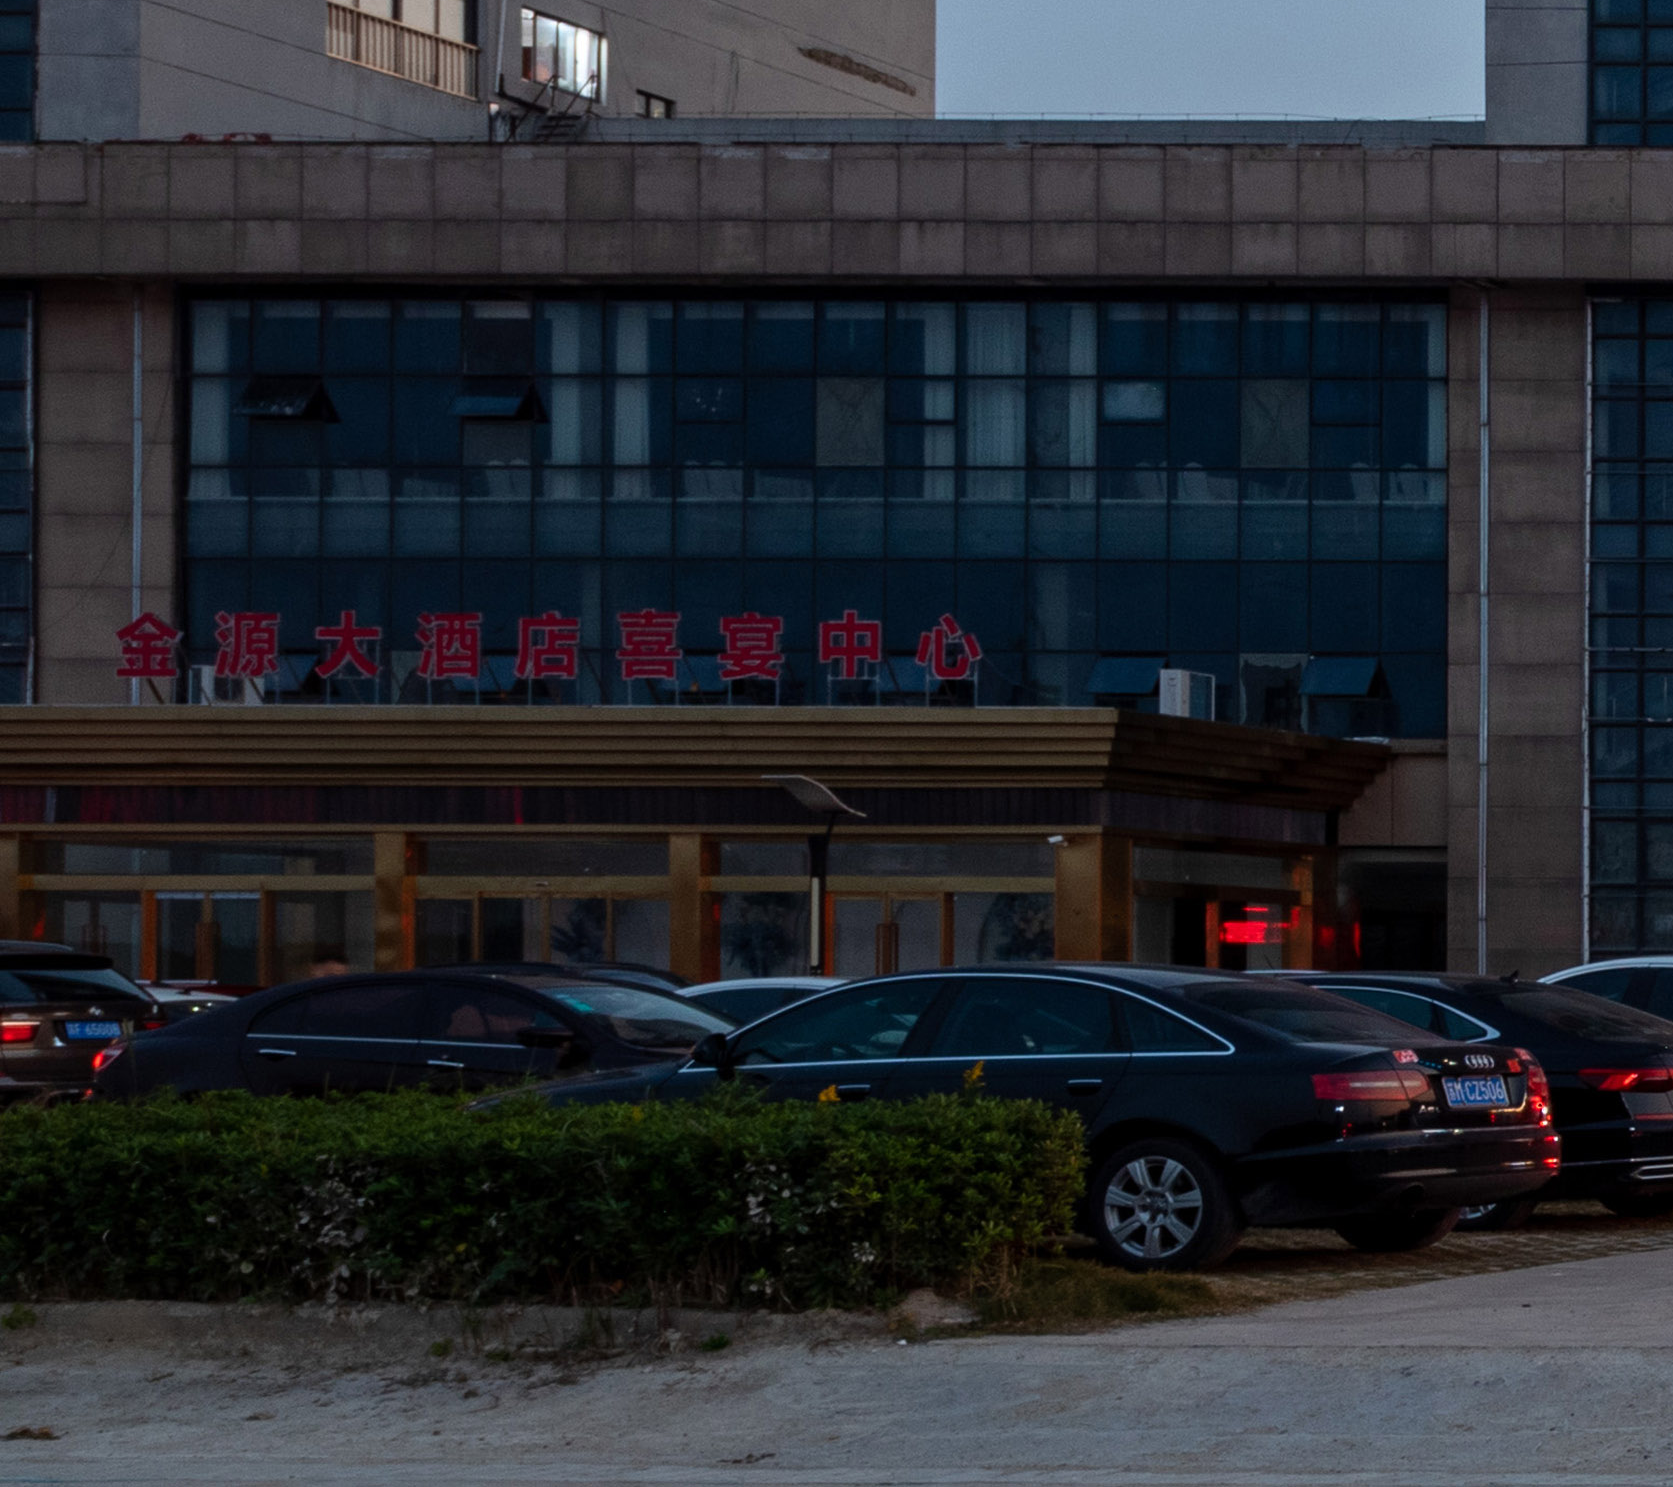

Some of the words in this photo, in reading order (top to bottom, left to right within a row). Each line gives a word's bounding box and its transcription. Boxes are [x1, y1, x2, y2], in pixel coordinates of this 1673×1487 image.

[115, 609, 983, 681] 金源大酒店喜宴中心
